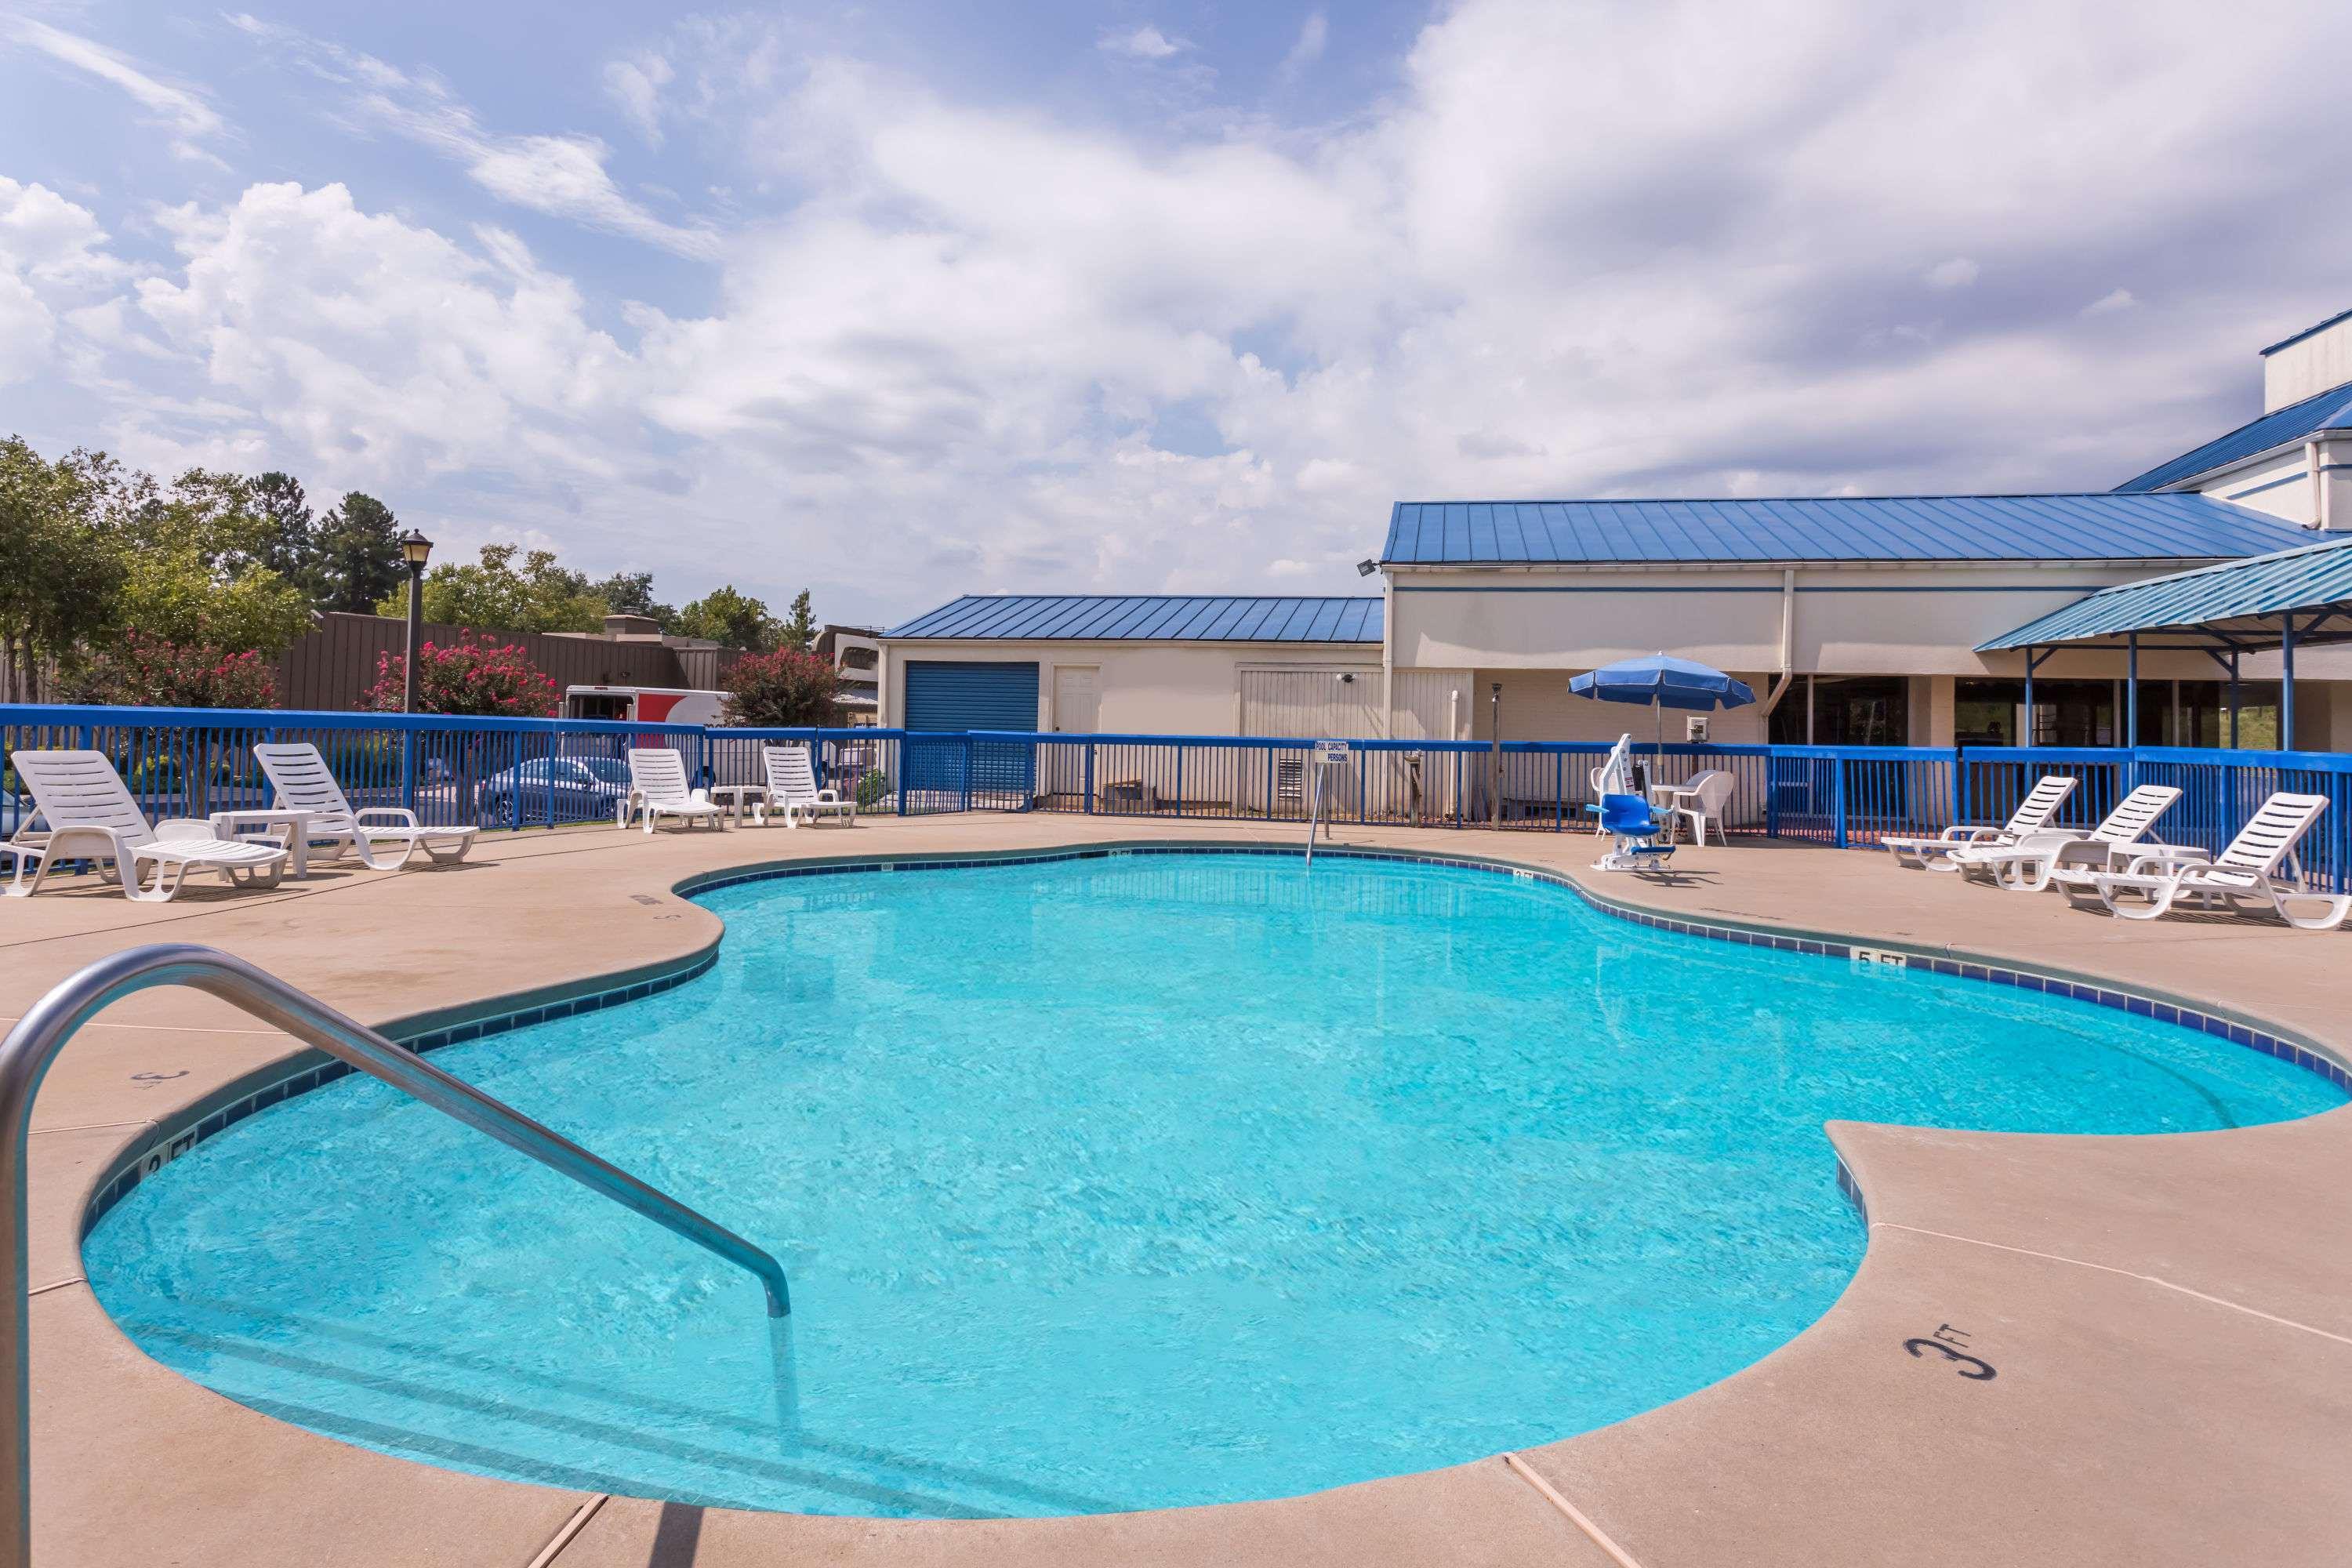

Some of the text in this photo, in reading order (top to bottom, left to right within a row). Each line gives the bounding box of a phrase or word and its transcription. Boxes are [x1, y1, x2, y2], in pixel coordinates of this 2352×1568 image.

[1316, 742, 1347, 750] POOL CAPACITY
[1327, 753, 1348, 761] PERSONS
[1903, 1323, 1997, 1381] 3 FT
